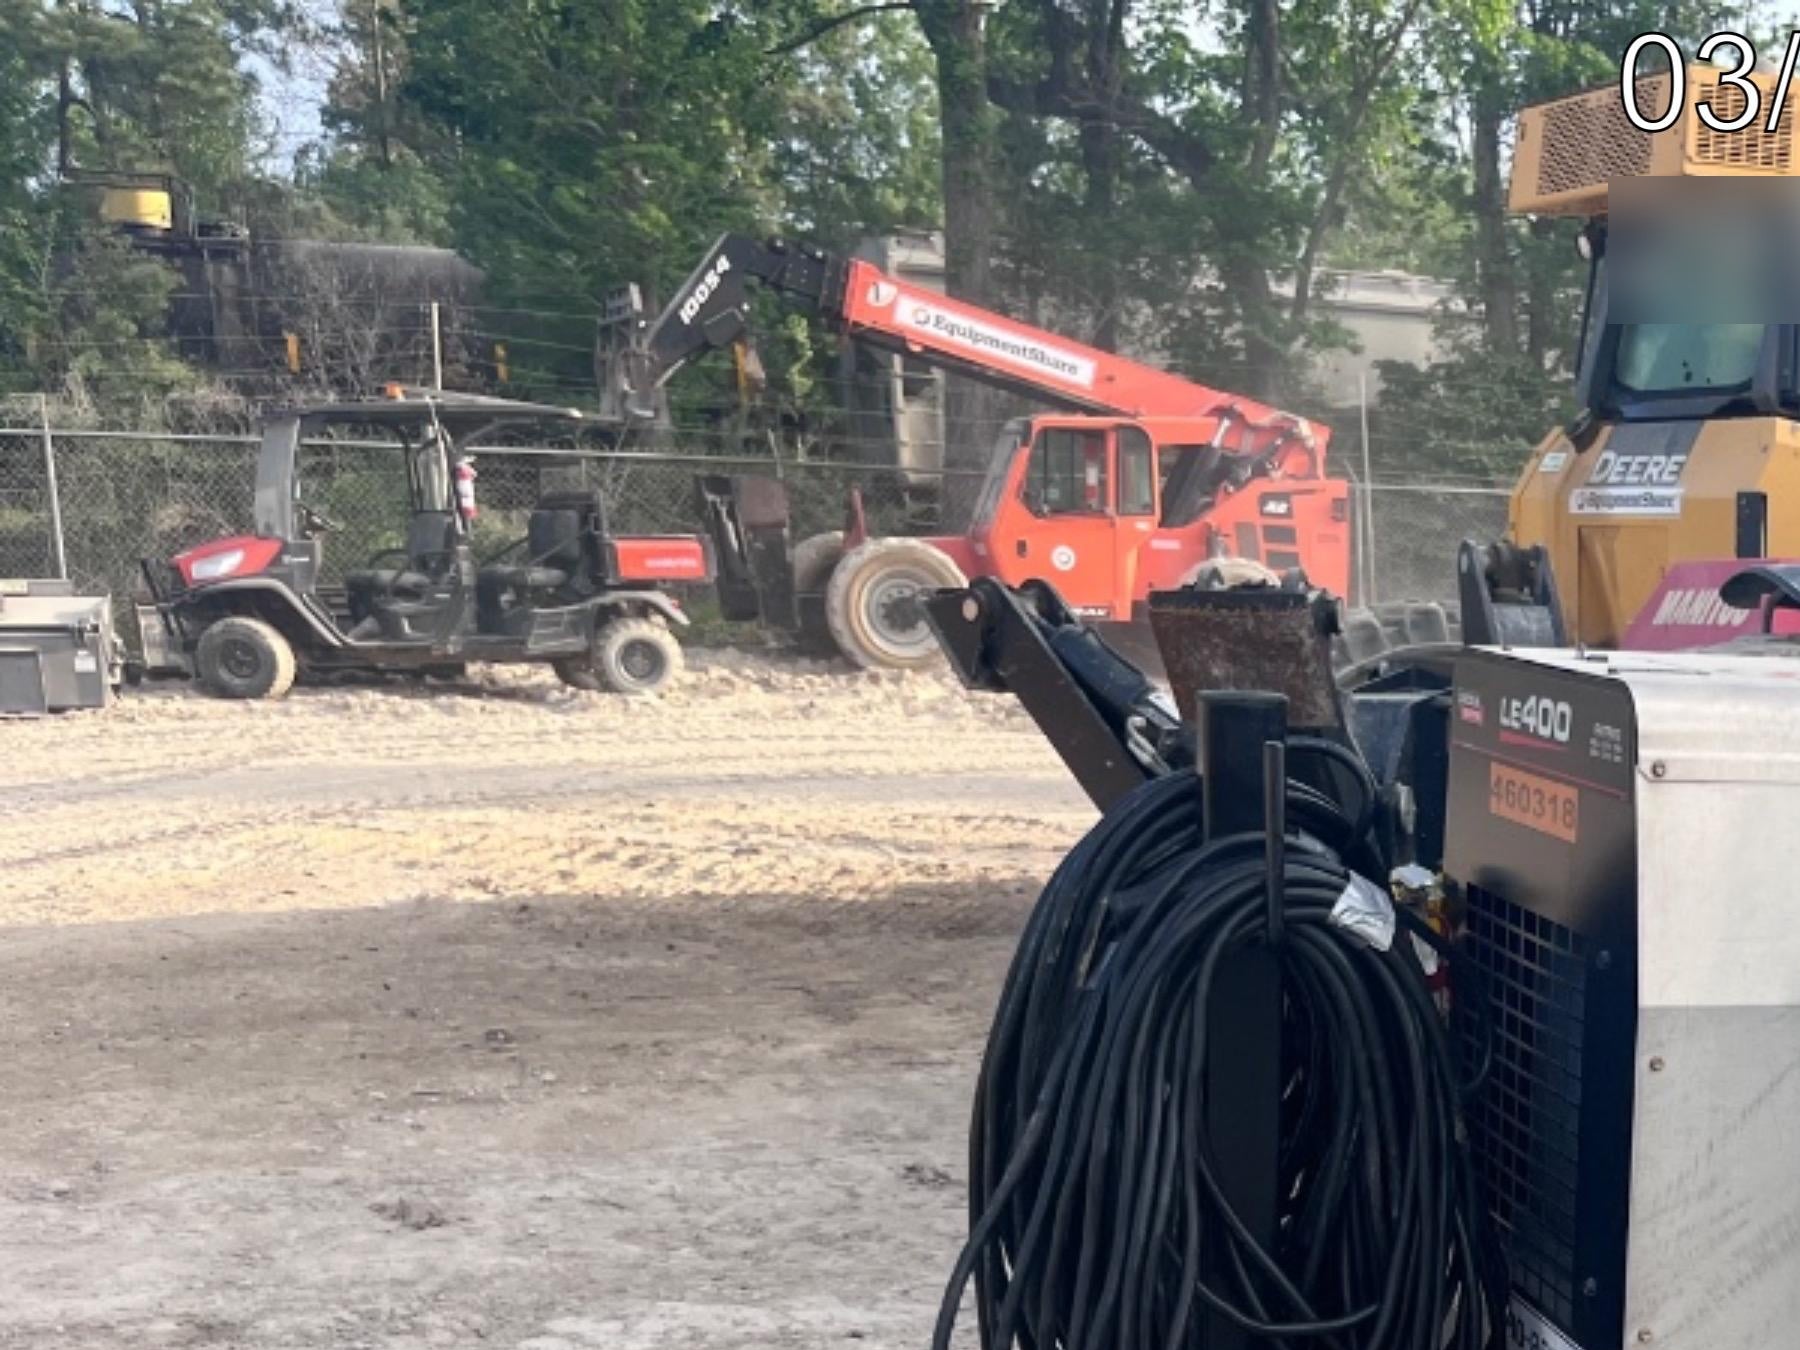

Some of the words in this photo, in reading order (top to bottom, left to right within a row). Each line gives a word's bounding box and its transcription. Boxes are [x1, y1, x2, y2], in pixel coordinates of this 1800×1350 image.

[679, 254, 731, 325] 10054
[932, 313, 1079, 376] EquipmentShare
[1589, 451, 1687, 483] DEERE
[1500, 696, 1572, 742] LE400
[1490, 776, 1576, 829] 460318
